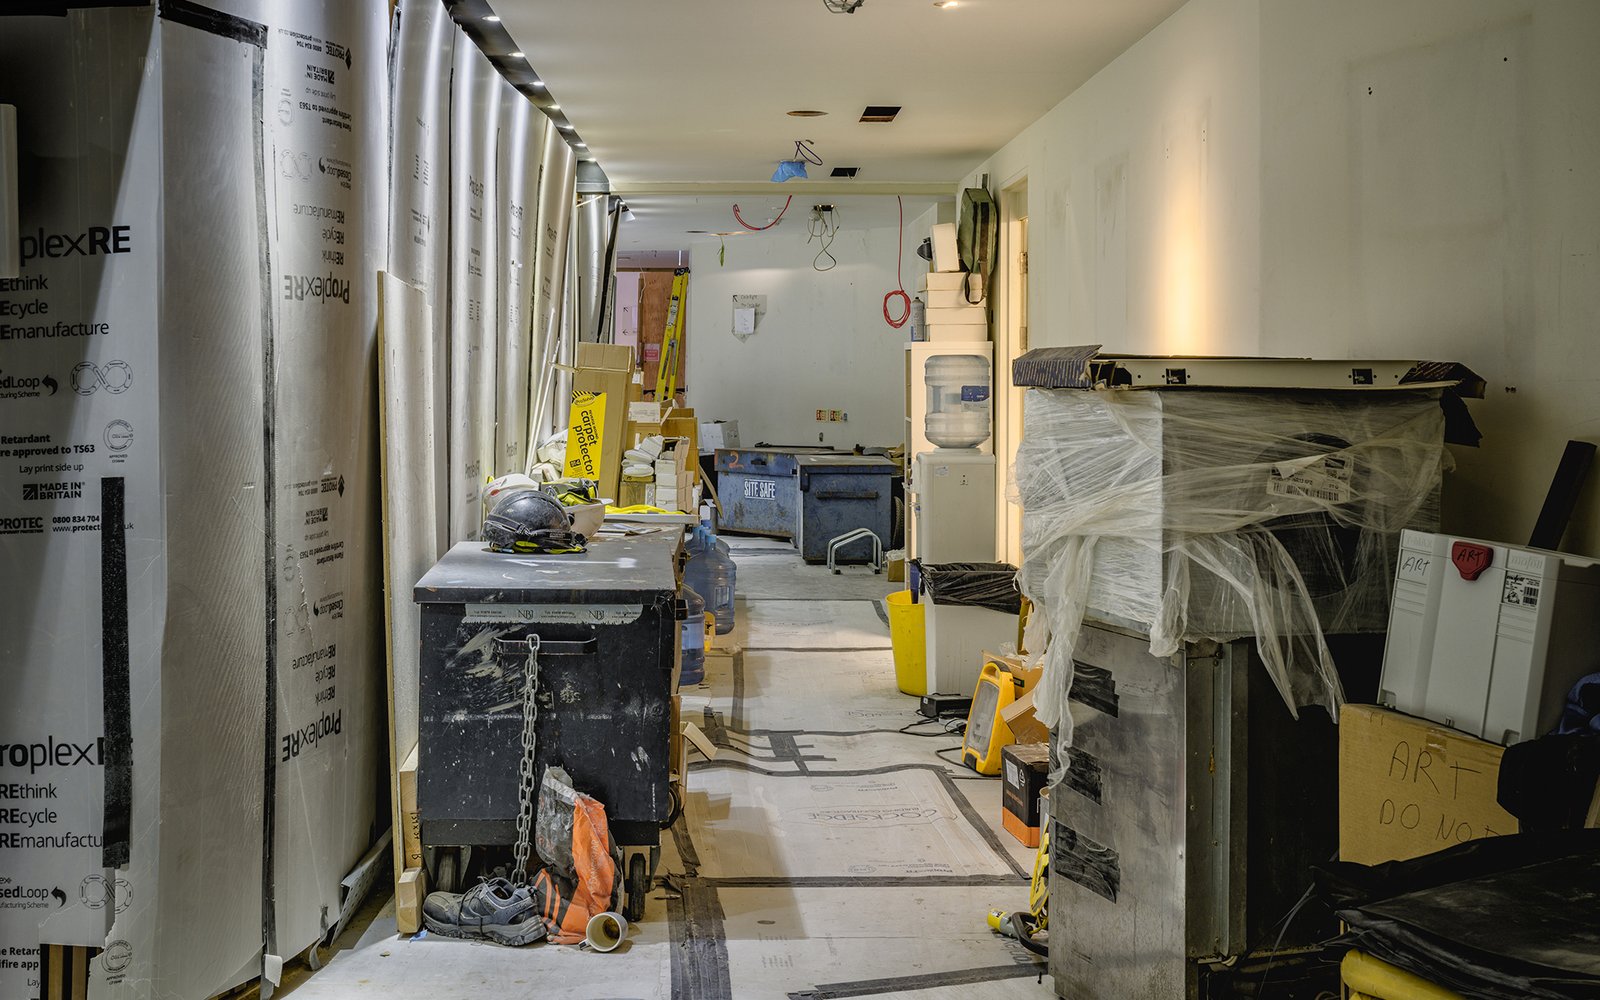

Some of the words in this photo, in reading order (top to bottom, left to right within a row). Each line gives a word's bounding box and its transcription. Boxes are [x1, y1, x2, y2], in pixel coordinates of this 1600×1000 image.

[326, 45, 344, 60] PROTEC
[306, 64, 328, 76] BRITAIN
[314, 73, 328, 82] MADE
[299, 101, 311, 111] TS63
[318, 106, 338, 116] approved
[293, 204, 344, 224] REmanufacture
[322, 226, 344, 245] REcycle
[20, 226, 131, 267] plexRE
[322, 250, 344, 266] REthink
[0, 275, 48, 292] Ethink
[284, 272, 350, 304] ProplexRE
[0, 299, 48, 320] Ecycle
[0, 322, 110, 340] Emanufacture
[580, 410, 598, 446] carpet
[0, 434, 51, 445] Retardant
[12, 446, 58, 458] approved
[61, 446, 71, 454] to
[73, 444, 95, 454] TS63
[573, 425, 595, 476] protector
[729, 450, 744, 469] 2
[20, 465, 33, 474] Lay
[34, 464, 54, 474] print
[56, 464, 72, 472] side
[74, 464, 84, 472] up
[40, 482, 68, 491] MADE
[70, 482, 82, 490] IN
[40, 491, 82, 500] BRITAIN
[321, 481, 337, 493] PROTEC
[744, 480, 758, 498] SITE
[759, 480, 776, 498] SAFE
[0, 517, 43, 529] PROTEC
[300, 550, 308, 559] TS63
[1457, 548, 1485, 566] ART
[1402, 556, 1430, 576] ART
[292, 644, 336, 670] REmanufacture
[316, 664, 336, 684] REcycle
[315, 686, 336, 706] REthink
[282, 708, 342, 762] ProplexRE
[0, 736, 133, 774] roplex
[1389, 741, 1482, 800] ART
[0, 783, 58, 799] REthink
[0, 808, 58, 828] REcycle
[1380, 799, 1420, 830] DO
[0, 832, 103, 848] REmanufactu
[0, 886, 49, 900] sedLoop
[9, 947, 40, 956] Retar
